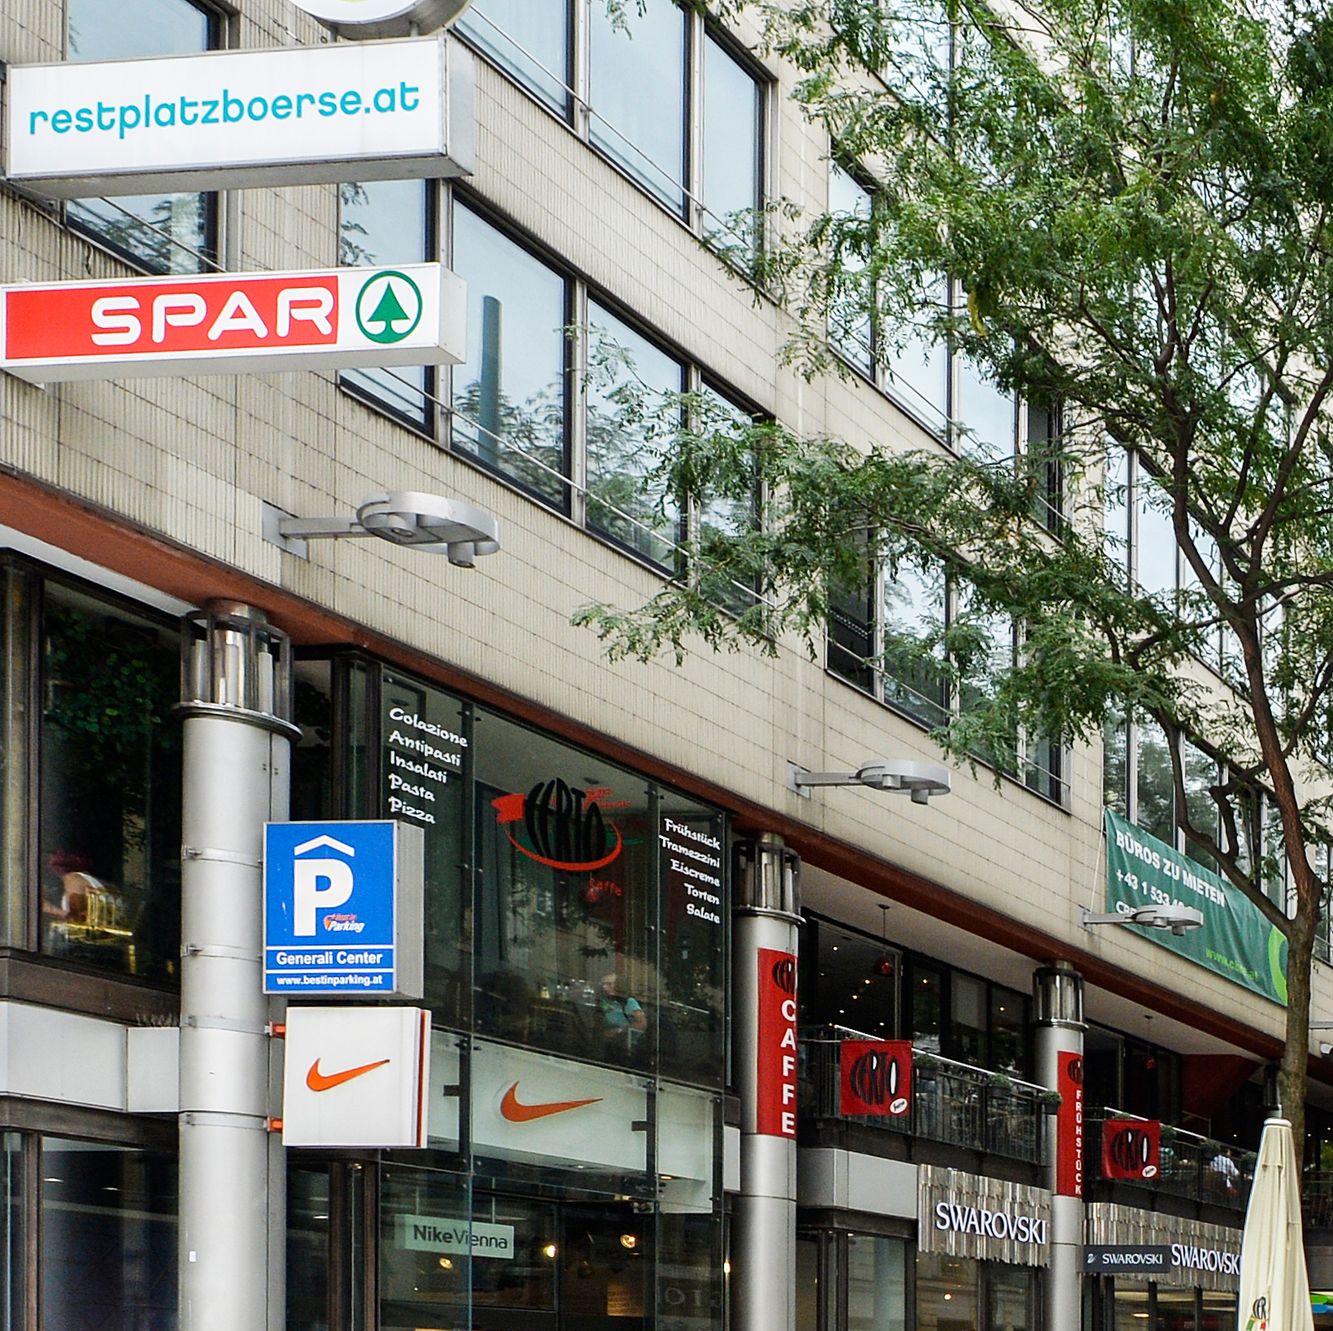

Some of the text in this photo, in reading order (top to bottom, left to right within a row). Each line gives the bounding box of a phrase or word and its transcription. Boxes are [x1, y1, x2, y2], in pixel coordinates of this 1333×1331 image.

[29, 81, 420, 139] restplatzboerse.at
[91, 287, 335, 347] SPAR
[389, 707, 468, 747] Colazione
[389, 730, 461, 766] Antipasti
[390, 751, 447, 783] Insalati
[389, 773, 435, 801] Pasta
[389, 796, 435, 824] Pizza
[664, 818, 720, 851] Frühstück
[659, 835, 720, 868] Tramezzini
[1116, 829, 1226, 907] BÜROS ZU MIETEN
[670, 859, 720, 887] Eiscreme
[1116, 869, 1138, 891] +43
[1150, 888, 1170, 907] 533
[294, 858, 353, 936] P
[684, 883, 720, 905] Torten
[686, 904, 720, 924] Salate
[276, 951, 383, 965] Generali Center
[277, 975, 383, 986] www.bestinparking.at
[414, 1224, 508, 1250] NikeVienna
[935, 1201, 1047, 1245] SWAROVSKI
[1102, 1253, 1163, 1265] SWAROVSKI
[1171, 1243, 1242, 1276] SWAROVSK
